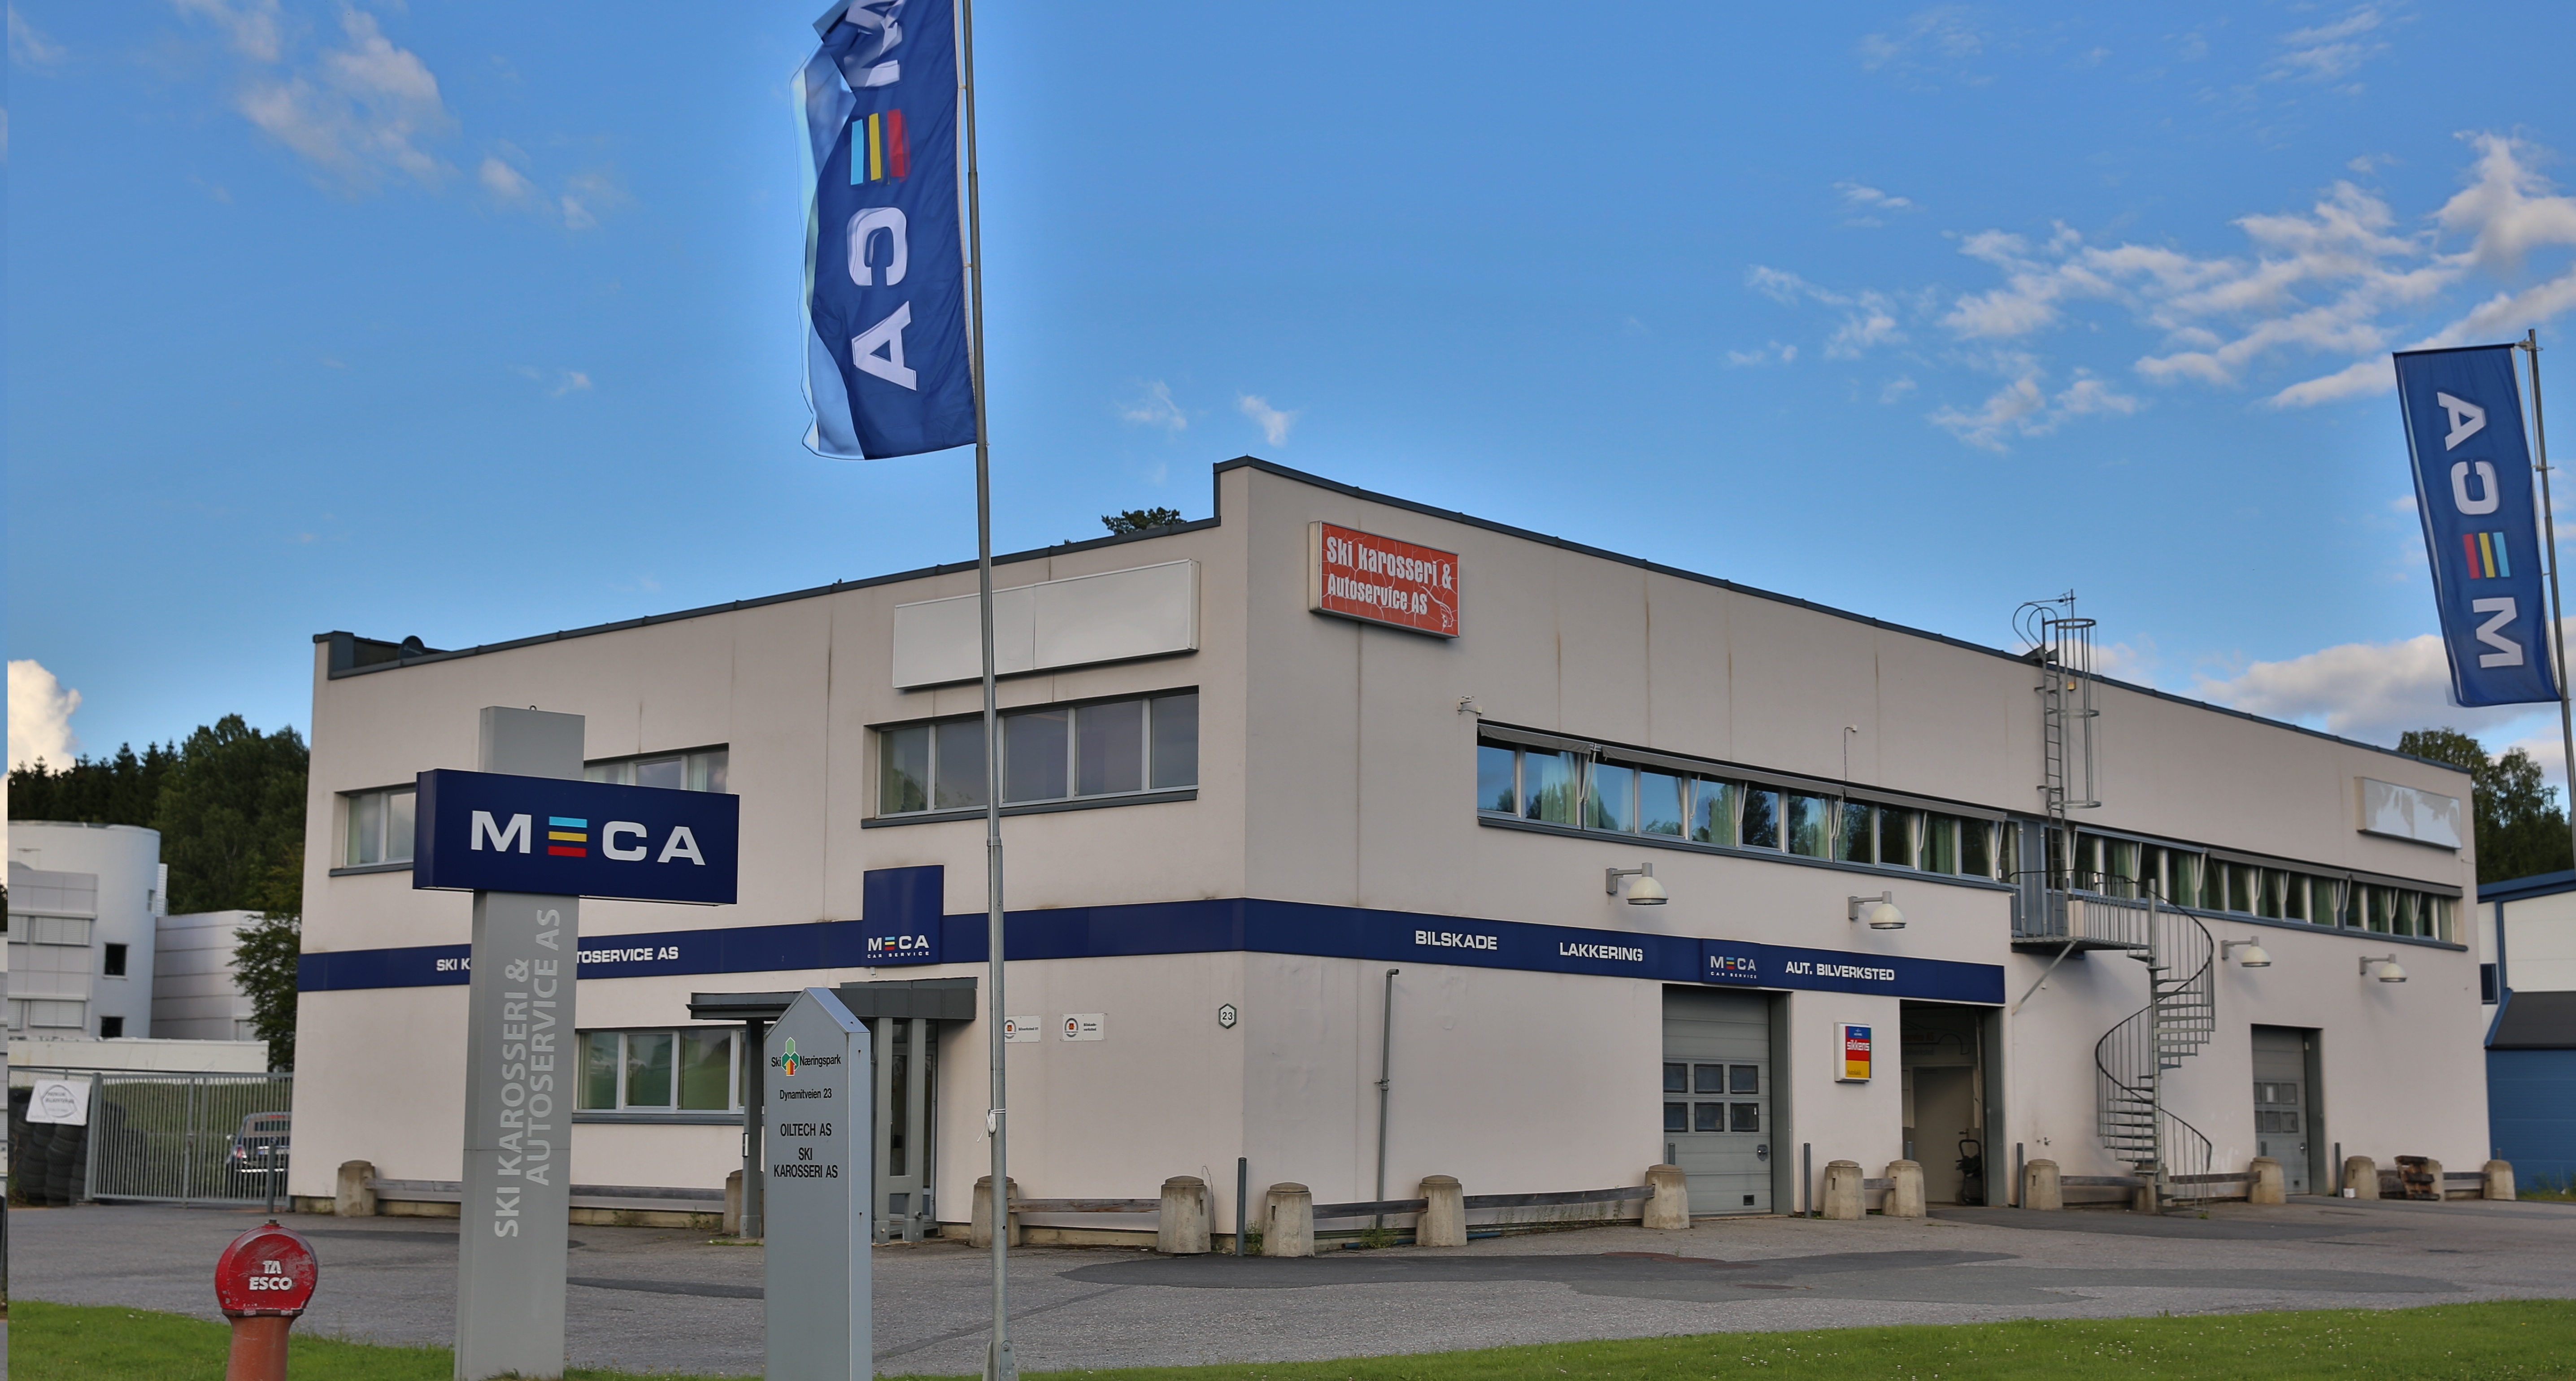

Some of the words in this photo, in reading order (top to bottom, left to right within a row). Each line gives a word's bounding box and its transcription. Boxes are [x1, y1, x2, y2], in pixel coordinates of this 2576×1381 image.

[1327, 536, 1353, 567] Ski
[1358, 543, 1437, 586] karosseri
[1441, 563, 1453, 590] &
[1327, 573, 1408, 611] Autoservice
[1411, 591, 1428, 615] AS
[471, 811, 706, 865] MECA
[536, 908, 560, 951] AS
[868, 935, 929, 951] MECA
[1415, 930, 1497, 950] BILSKADE
[437, 959, 457, 971] SKI
[657, 947, 679, 960] AS
[1560, 942, 1643, 962] LAKKERING
[505, 958, 529, 982] &
[1710, 956, 1756, 971] MECA
[1785, 961, 1813, 975] AUT.
[1816, 964, 1895, 981] BILVERKSTED
[1222, 1012, 1233, 1020] 23
[771, 1056, 781, 1067] Ski
[800, 1054, 841, 1068] Næringspark
[526, 960, 558, 1186] AUTOSERVICE
[498, 992, 528, 1175] KAROSSERI
[780, 1089, 821, 1101] Dynamitveien
[823, 1088, 832, 1099] 23
[780, 1123, 816, 1137] OILTECH
[819, 1122, 832, 1137] AS
[798, 1147, 813, 1161] SKI
[774, 1164, 822, 1178] KAROSSERI
[826, 1164, 838, 1178] AS
[494, 1187, 520, 1237] SKI
[263, 1260, 282, 1274] TA
[249, 1277, 292, 1290] ESCO
